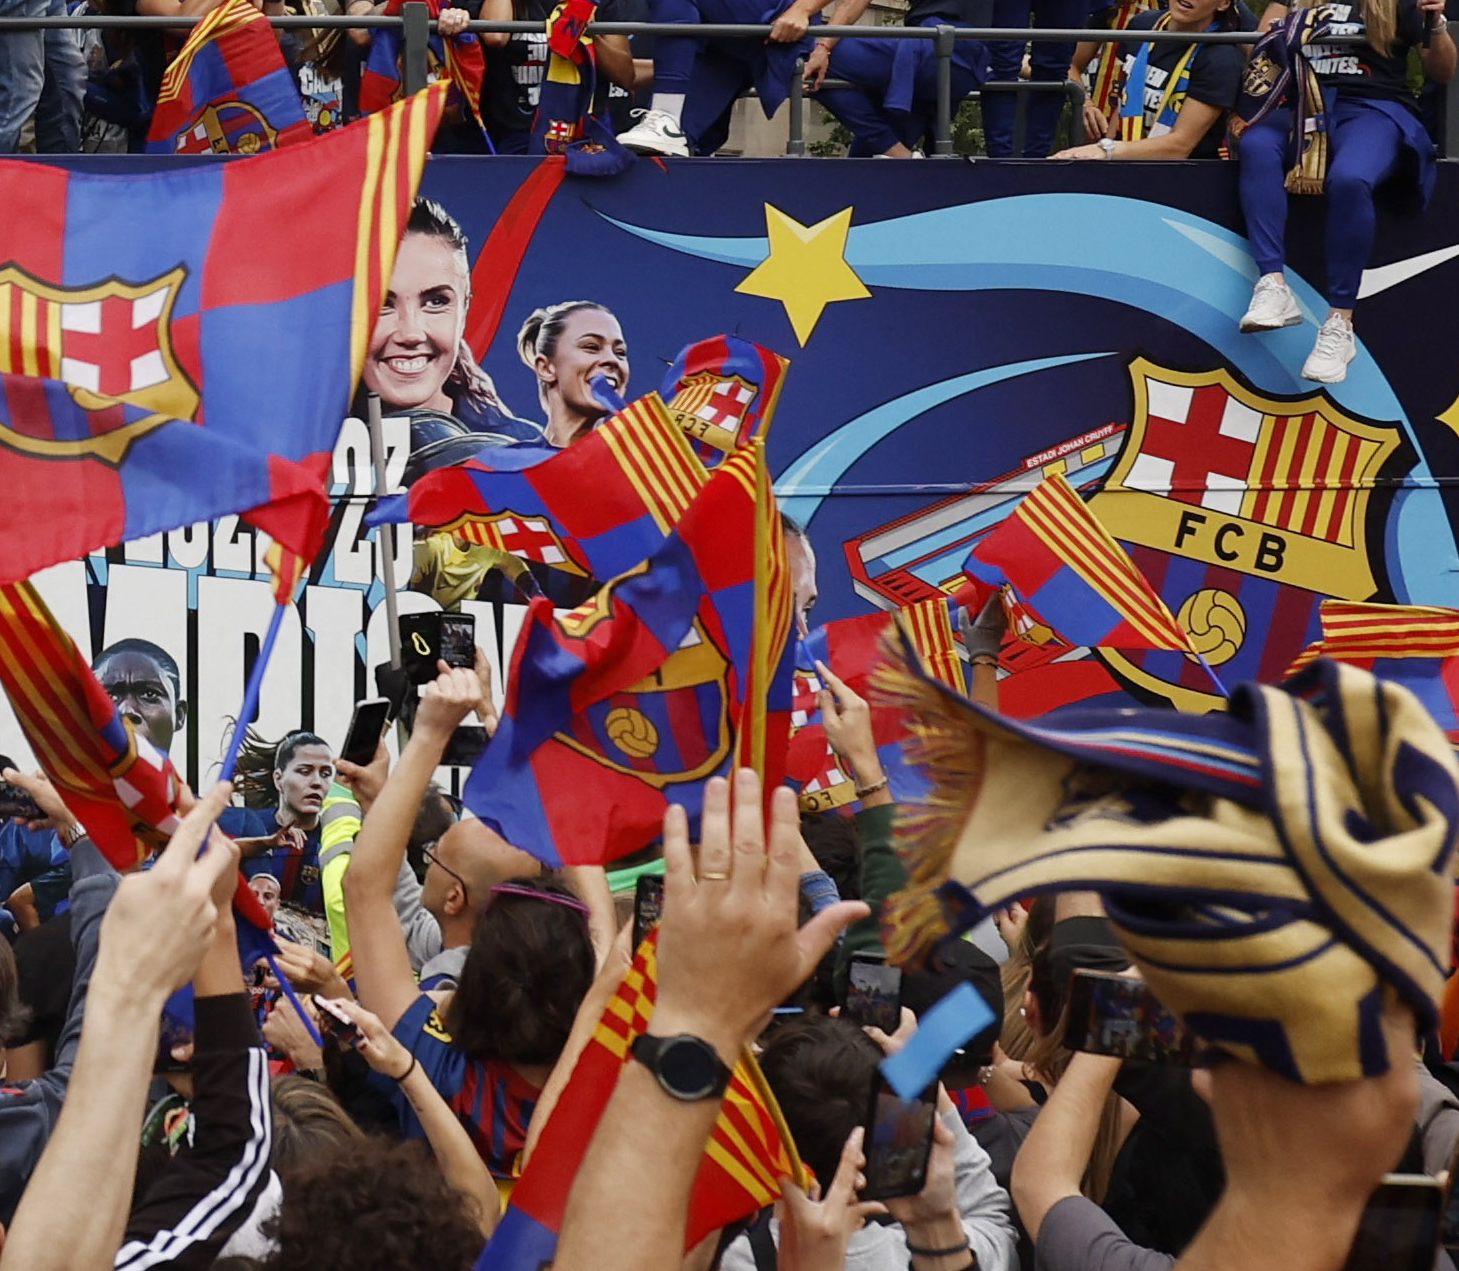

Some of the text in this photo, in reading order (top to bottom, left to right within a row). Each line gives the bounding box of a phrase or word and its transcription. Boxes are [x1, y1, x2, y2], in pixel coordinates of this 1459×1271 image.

[1026, 424, 1114, 468] ESTADI JOHAN CRUYFF
[1174, 510, 1288, 574] FCB
